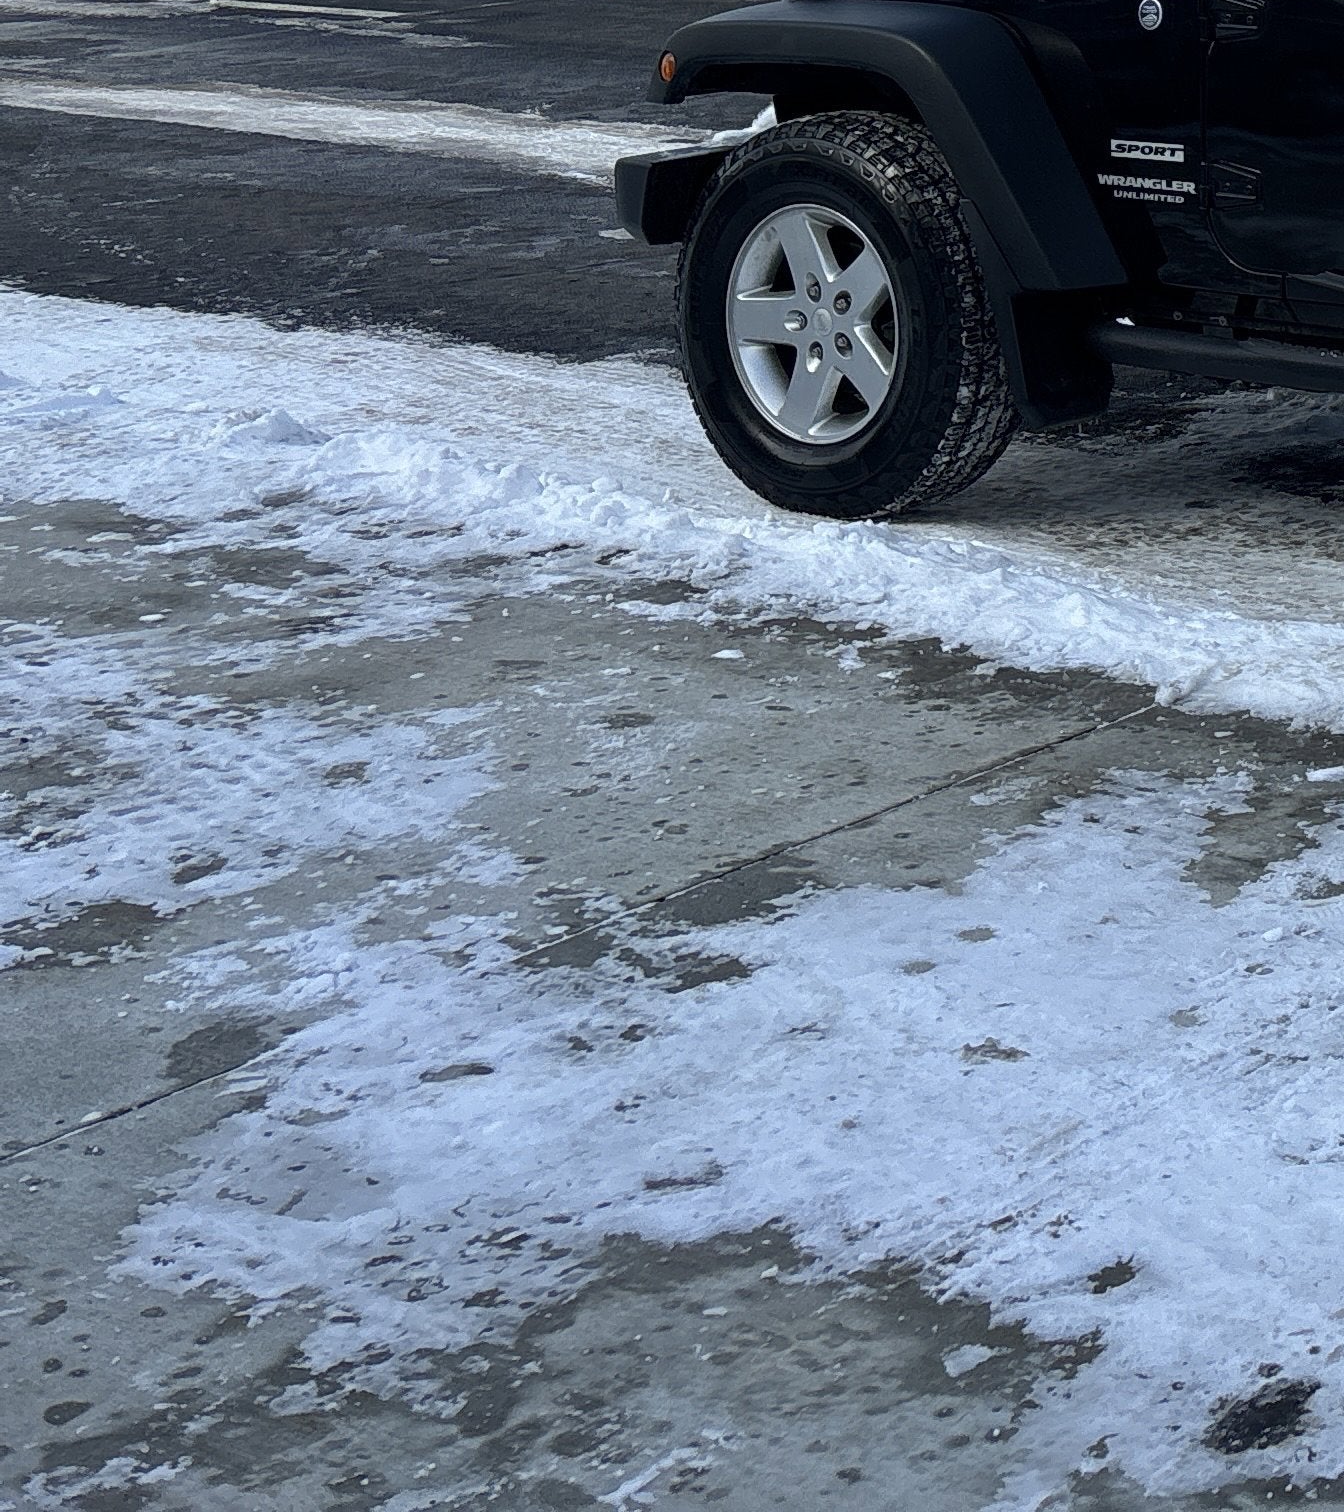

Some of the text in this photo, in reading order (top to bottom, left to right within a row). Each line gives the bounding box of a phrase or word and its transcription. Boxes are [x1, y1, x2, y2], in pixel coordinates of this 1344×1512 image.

[1112, 143, 1183, 157] SPORT
[1096, 173, 1198, 195] WRANGLER
[1113, 189, 1185, 204] UNLIMITED
